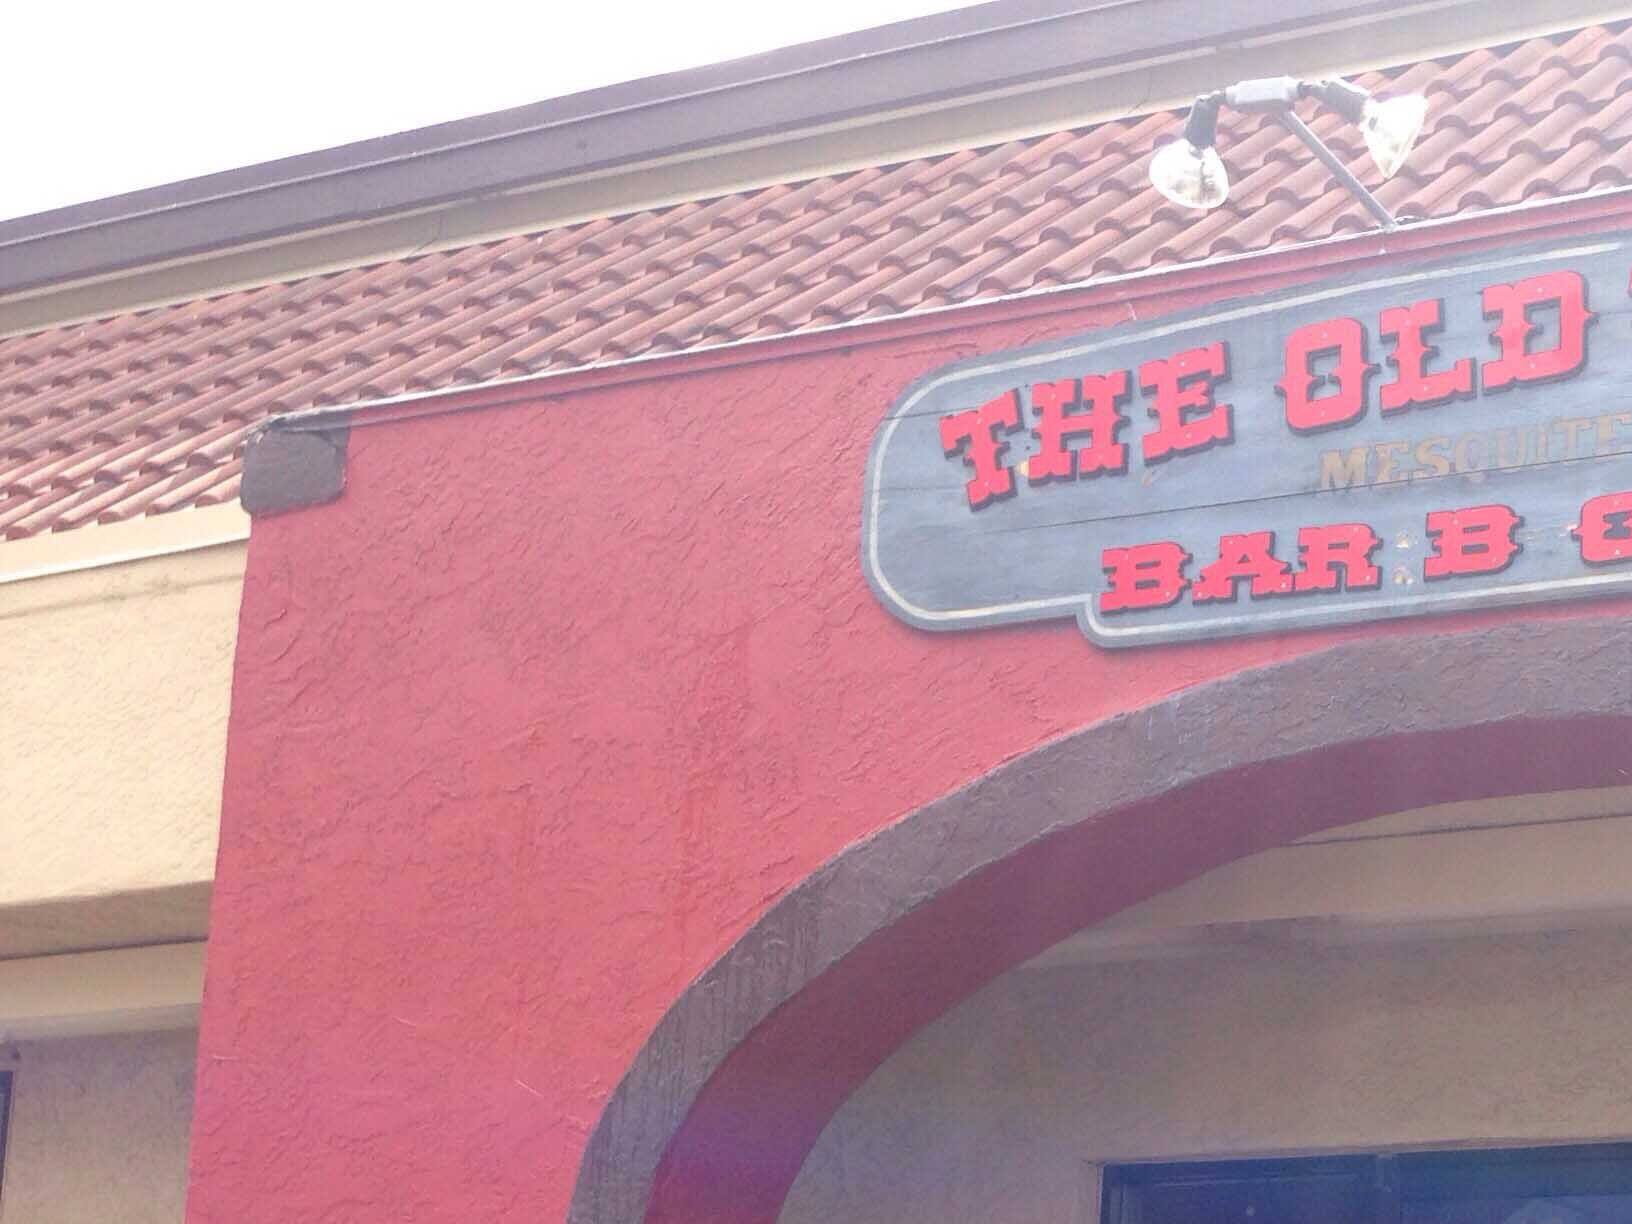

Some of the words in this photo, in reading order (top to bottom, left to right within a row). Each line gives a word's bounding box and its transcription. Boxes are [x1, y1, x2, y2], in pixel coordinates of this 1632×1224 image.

[939, 341, 1233, 511] THE
[1276, 271, 1597, 435] OLD
[1099, 522, 1383, 613] BAR
[1423, 504, 1526, 581] B
